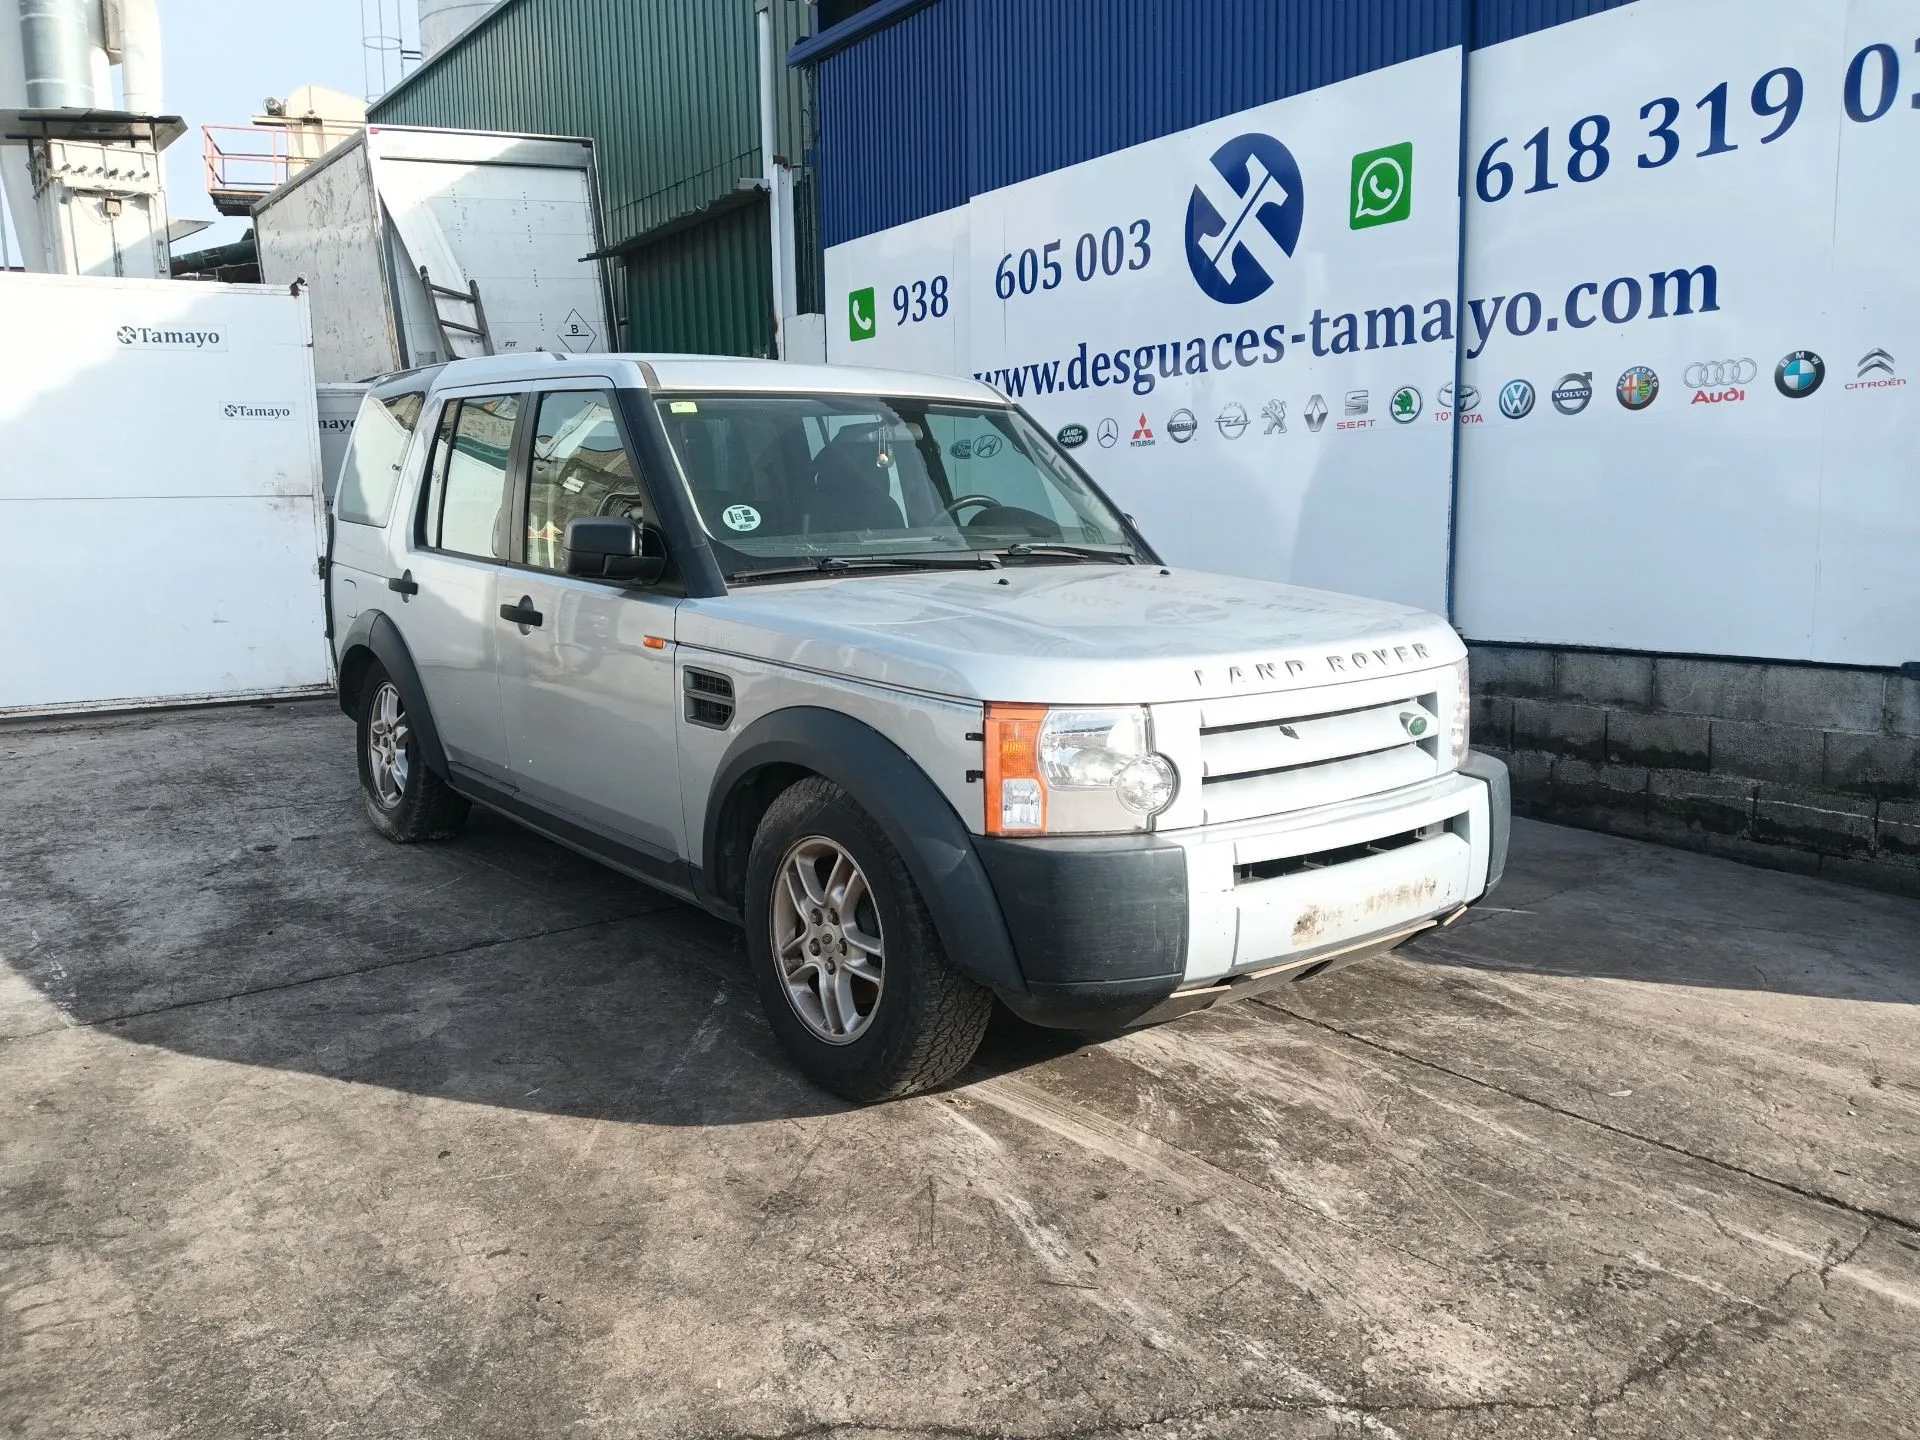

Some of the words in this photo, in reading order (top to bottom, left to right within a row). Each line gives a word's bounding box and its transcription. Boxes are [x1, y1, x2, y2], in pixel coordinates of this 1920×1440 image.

[1475, 114, 1611, 203] 618
[1636, 66, 1804, 169] 319
[1843, 36, 1920, 123] 0
[893, 275, 949, 326] 938
[995, 238, 1062, 300] 605
[1075, 218, 1151, 282] 003
[571, 324, 579, 334] B
[138, 327, 220, 347] Tamayo
[1779, 351, 1821, 368] BMW
[1555, 389, 1590, 399] VOLVO
[237, 405, 290, 419] Tamayo
[1336, 419, 1377, 430] SEAT
[1063, 428, 1080, 437] LAND
[1064, 435, 1084, 444] ROVER
[1130, 439, 1156, 448] MITSUBISHI
[1326, 642, 1431, 673] ROVER
